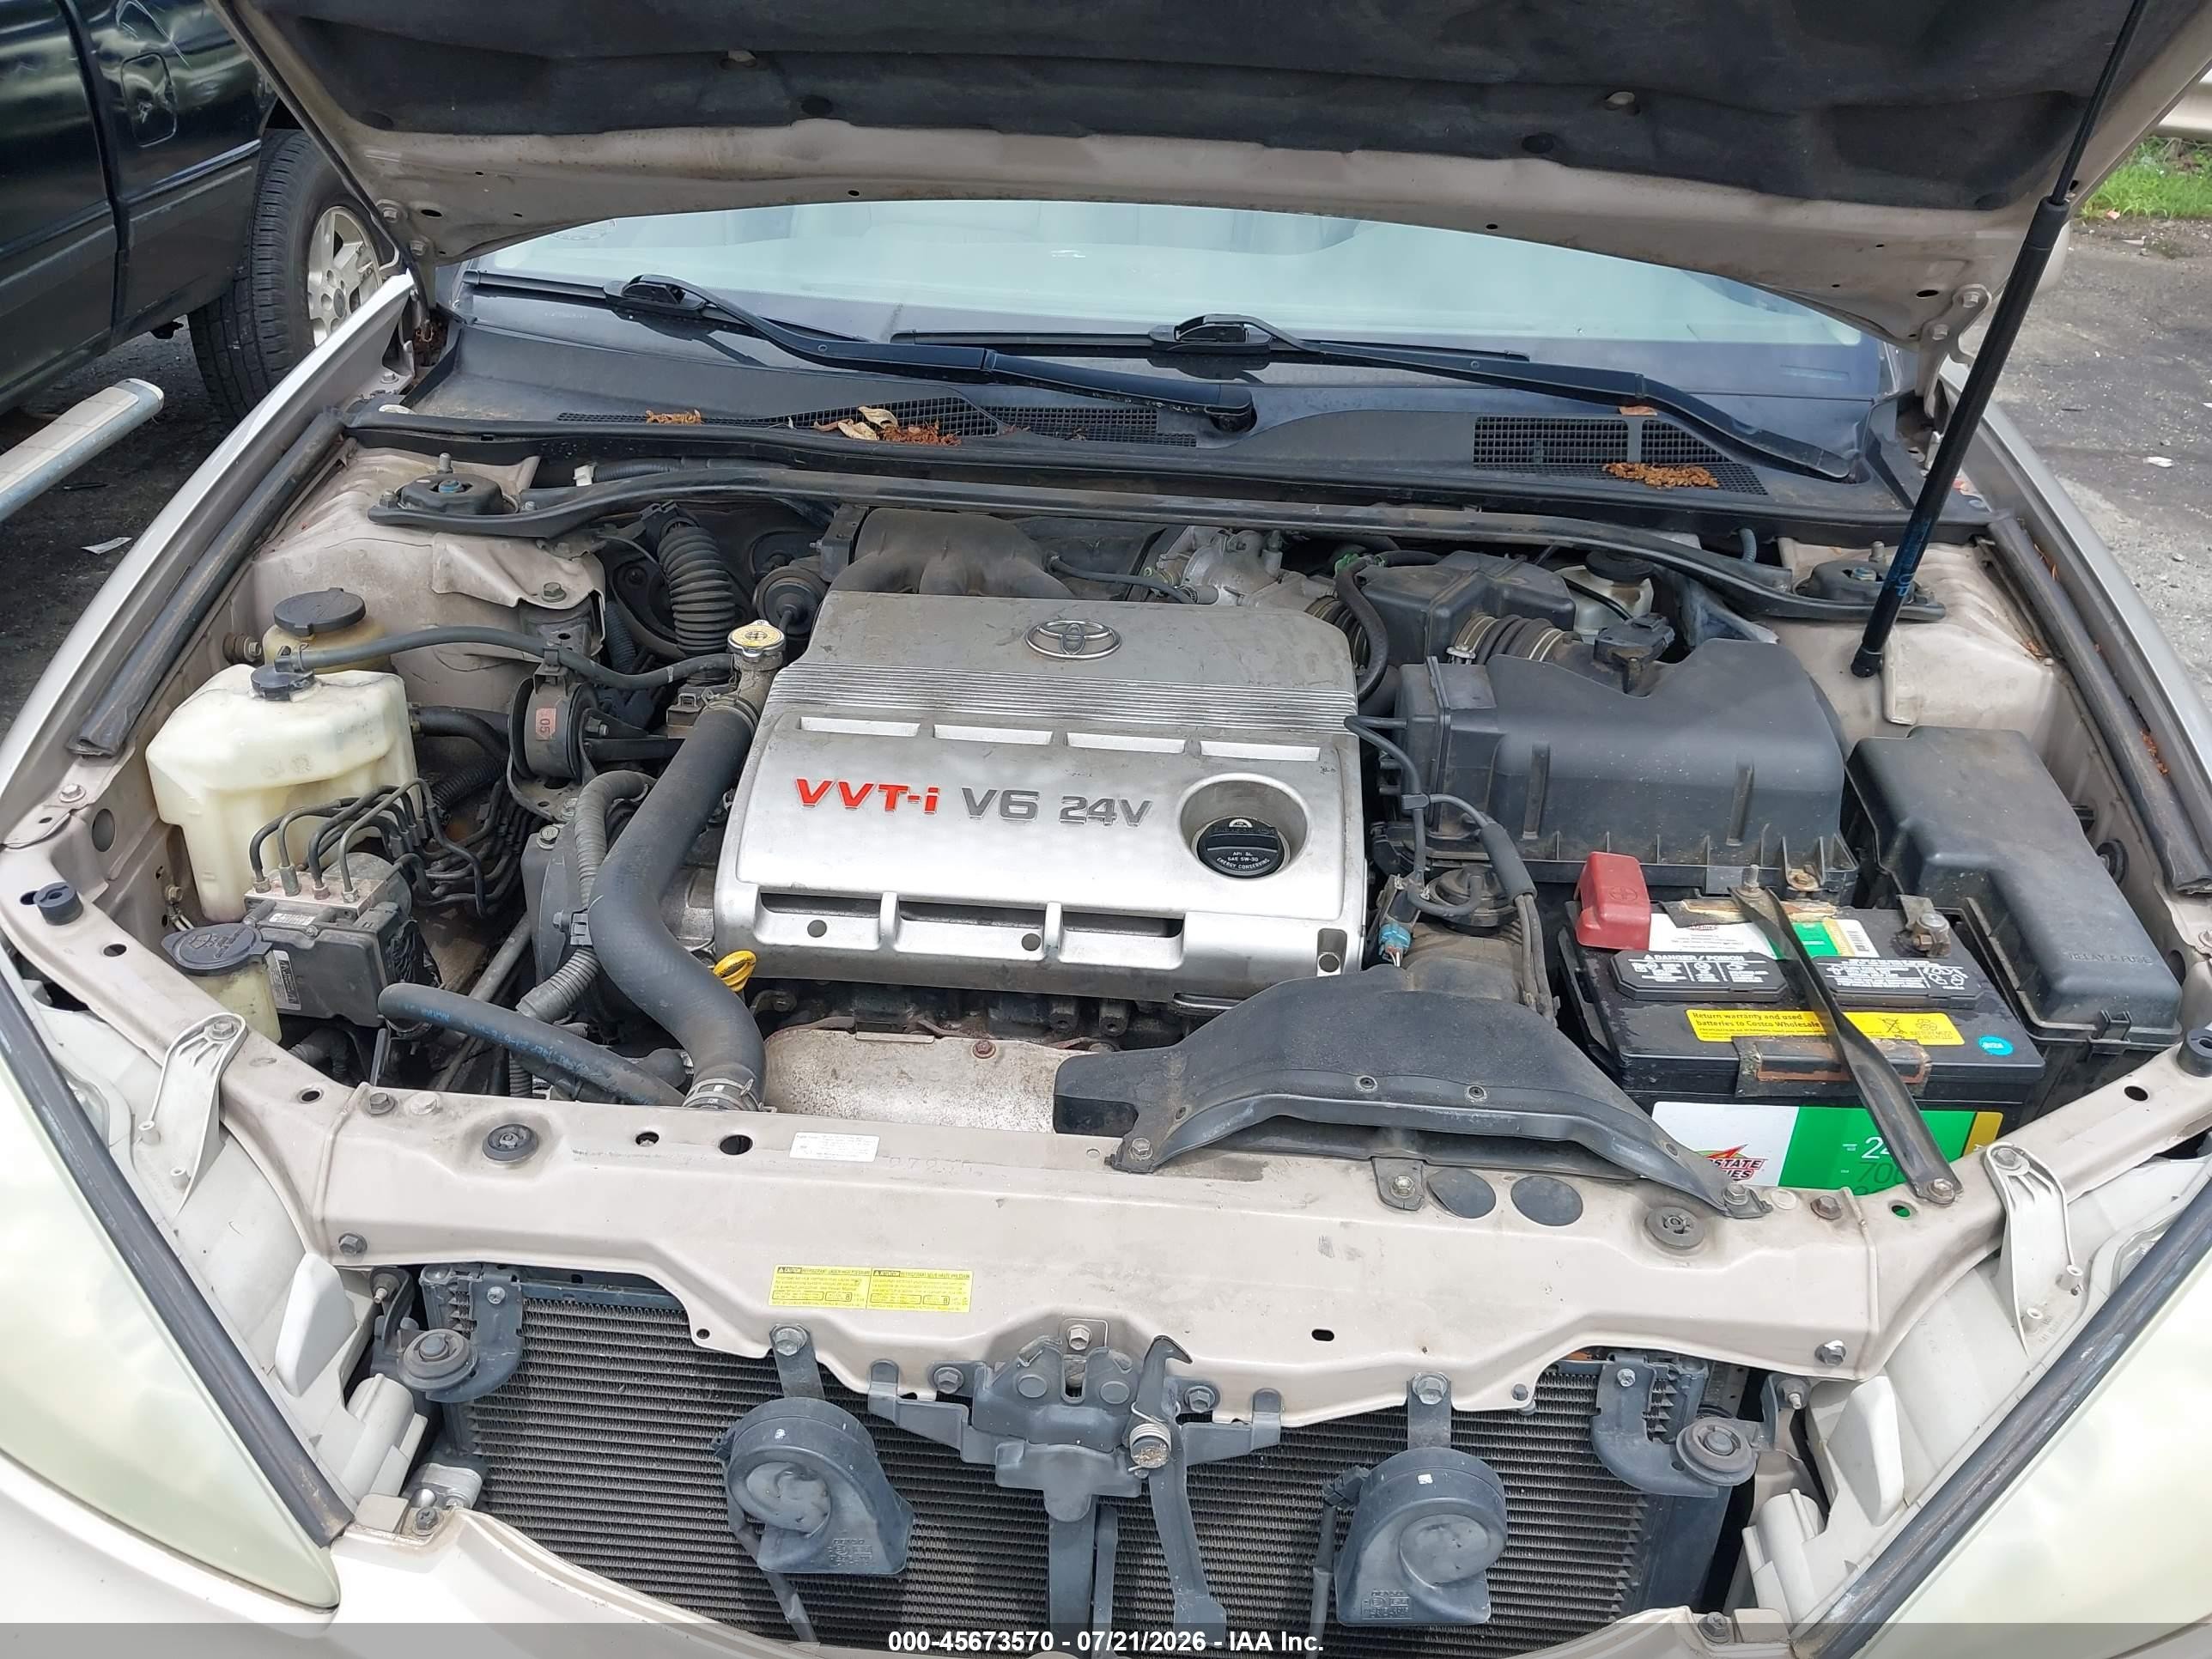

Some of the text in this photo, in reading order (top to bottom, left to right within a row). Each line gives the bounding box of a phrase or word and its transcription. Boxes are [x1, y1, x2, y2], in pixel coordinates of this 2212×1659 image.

[539, 718, 550, 733] 05
[796, 778, 1152, 827] VVT-i V6 24V
[1217, 857, 1271, 869] ENERGY CONSERVING
